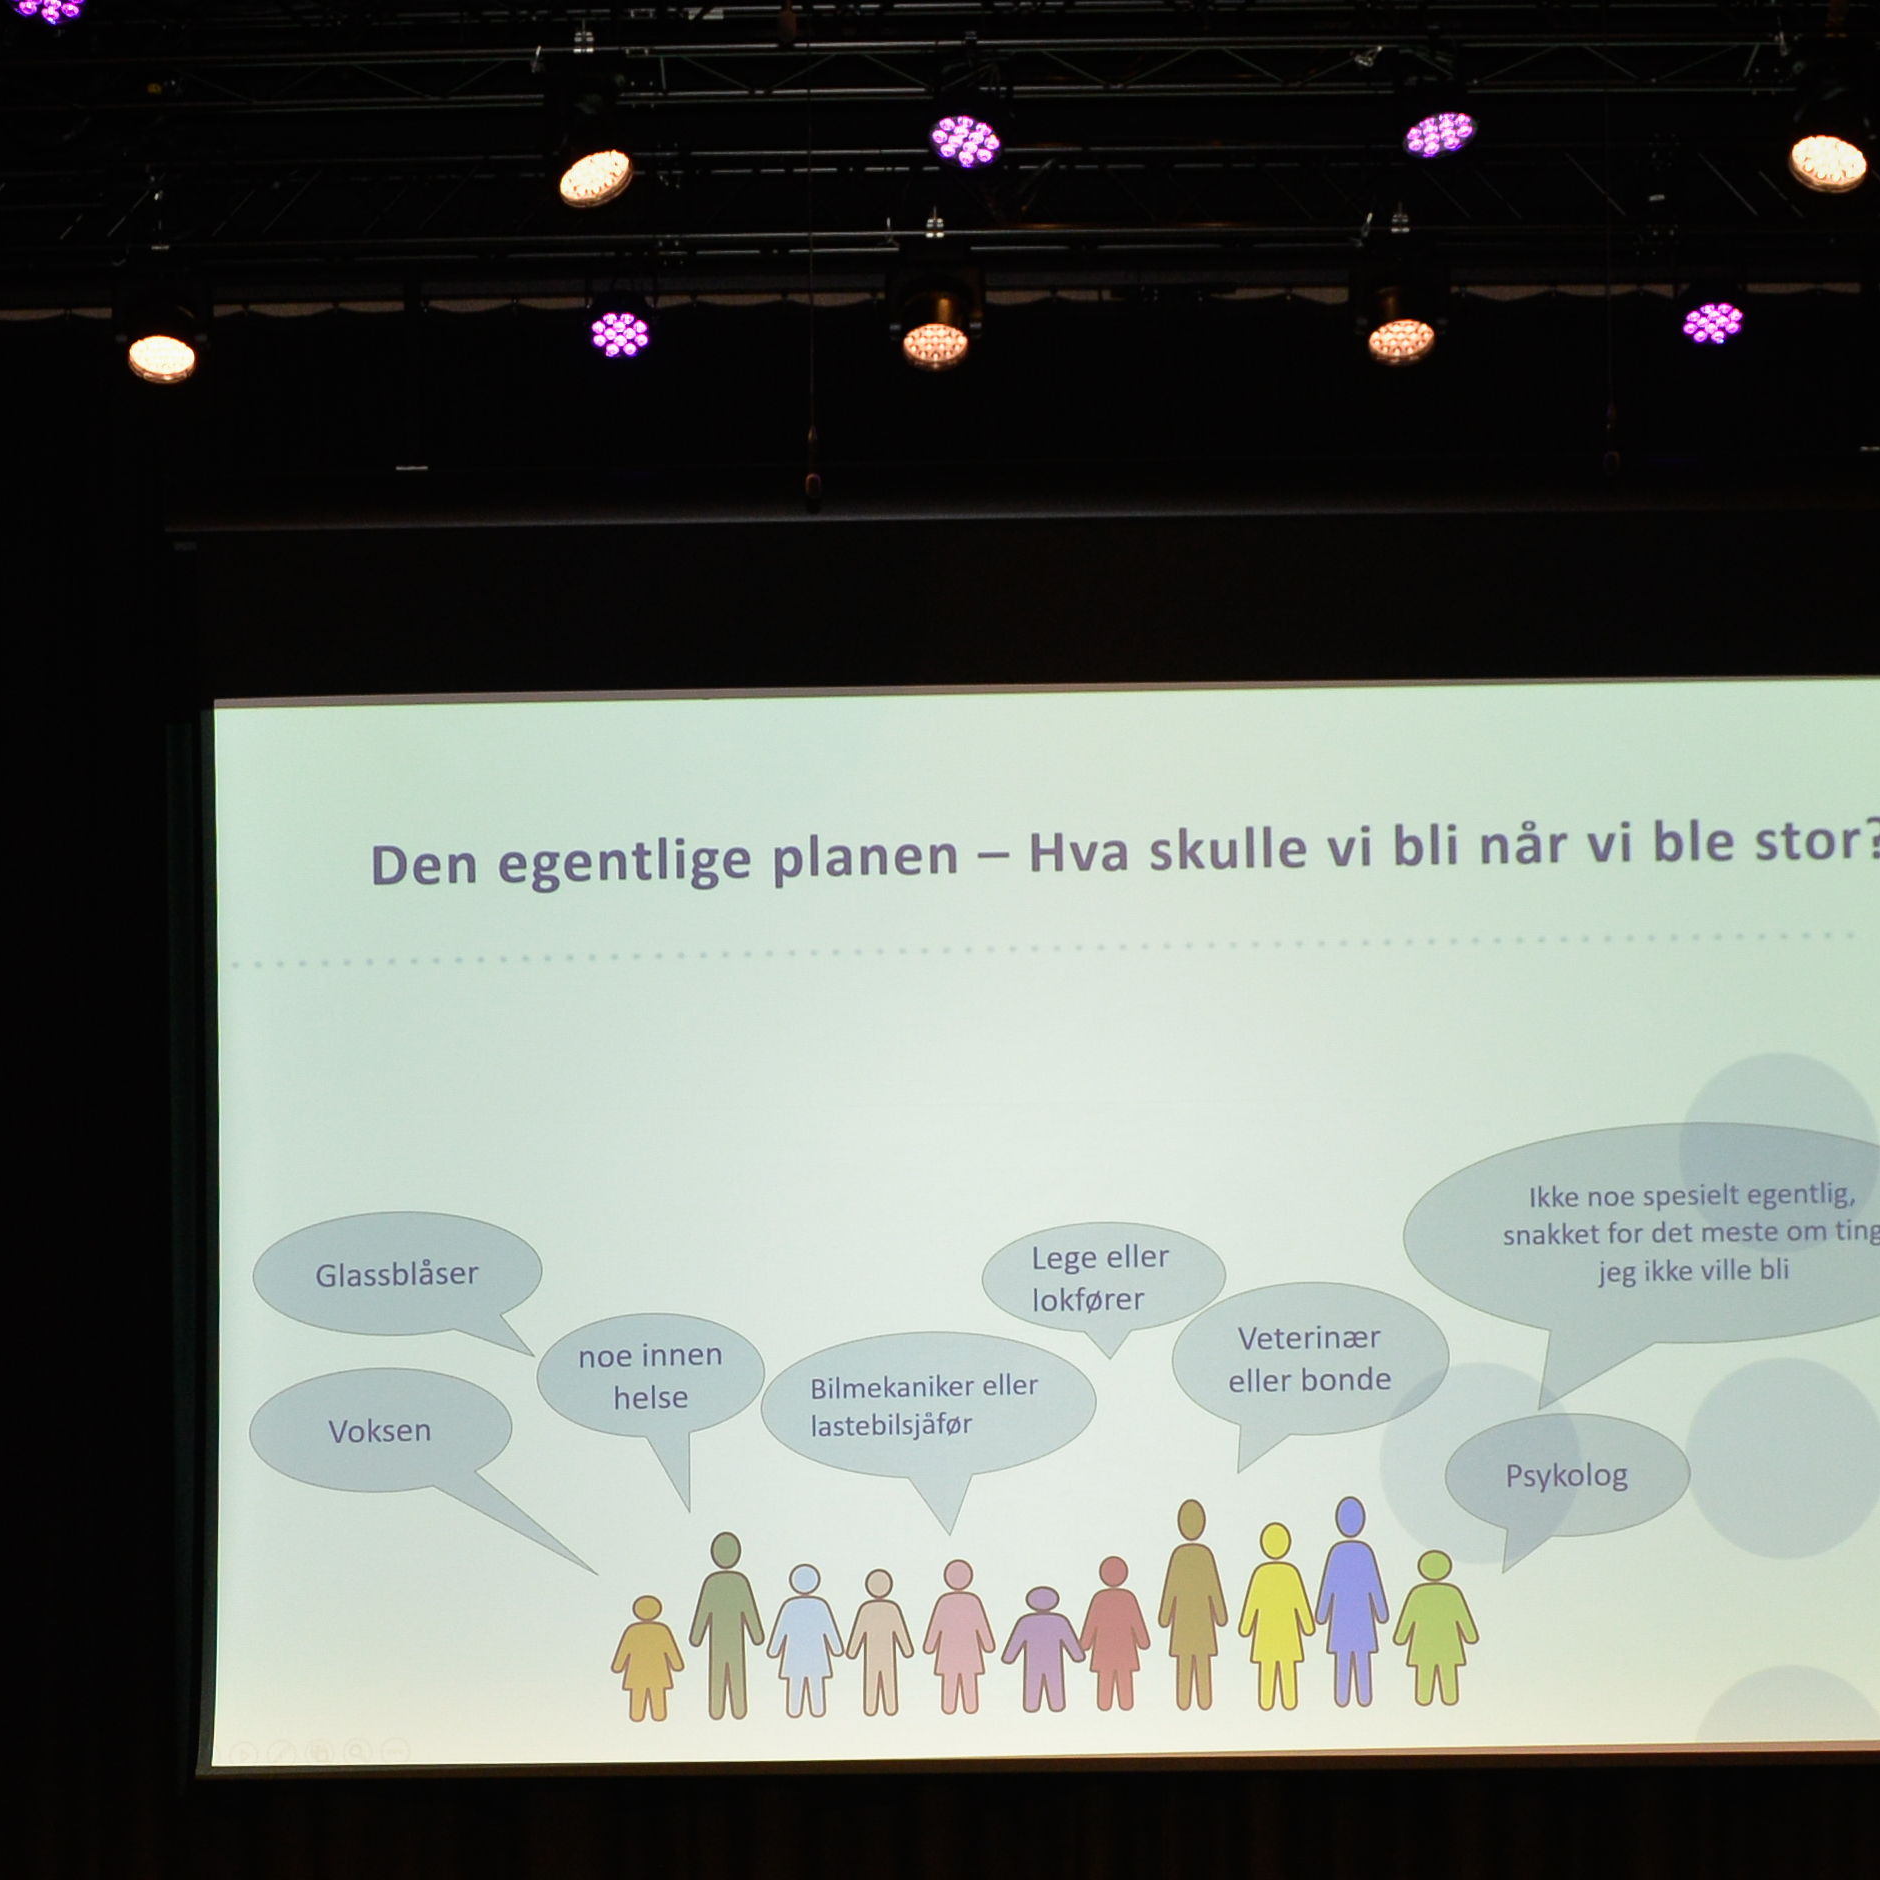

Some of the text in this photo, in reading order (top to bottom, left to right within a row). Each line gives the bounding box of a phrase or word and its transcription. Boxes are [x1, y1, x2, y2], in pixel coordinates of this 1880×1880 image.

[372, 844, 477, 886] Den
[498, 836, 752, 895] egentlige
[773, 833, 958, 890] planen
[1030, 831, 1128, 873] Hva
[1150, 825, 1308, 872] skulle
[1326, 824, 1371, 868] vi
[1394, 822, 1458, 867] bli
[1480, 819, 1569, 866] når
[1586, 820, 1631, 863] vi
[1654, 818, 1735, 863] ble
[1530, 1181, 1856, 1212] Ikke noe spesielt egentlig,
[1503, 1222, 1601, 1246] snakket
[1607, 1220, 1645, 1245] for
[1651, 1220, 1694, 1244] det
[1701, 1222, 1779, 1243] meste
[1786, 1224, 1828, 1242] om
[315, 1258, 480, 1288] Glassblåser
[1030, 1242, 1170, 1276] Lege eller
[1597, 1257, 1789, 1289] jeg ikke ville bli
[1030, 1285, 1146, 1316] lokfører
[1237, 1324, 1382, 1351] Veterinær
[577, 1342, 722, 1369] noe innen
[811, 1372, 1040, 1400] Bilmekaniker eller
[1228, 1365, 1392, 1394] eller bonde
[614, 1383, 689, 1411] helse
[327, 1417, 431, 1444] Voksen
[811, 1410, 974, 1442] lastebilsjåfør
[1507, 1461, 1629, 1494] Psykolog
